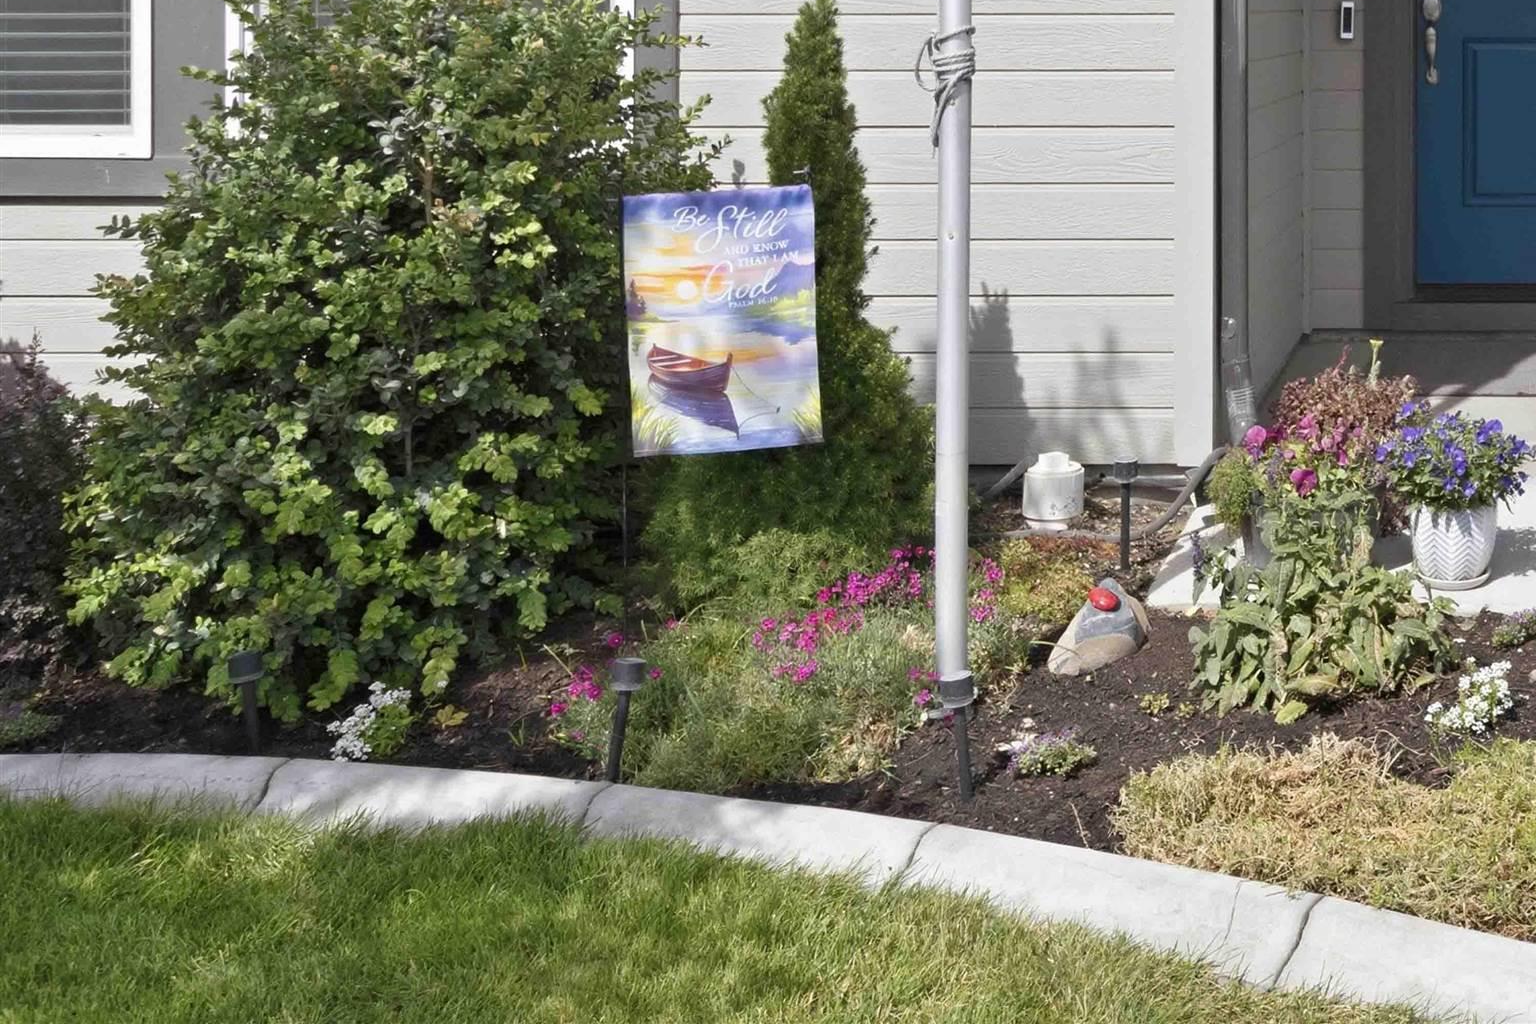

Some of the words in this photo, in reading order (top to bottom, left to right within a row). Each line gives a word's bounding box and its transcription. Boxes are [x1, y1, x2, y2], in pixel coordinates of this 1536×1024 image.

[673, 206, 710, 232] Be
[696, 205, 788, 253] Still
[753, 240, 789, 252] KNOW
[781, 251, 799, 262] AM
[704, 260, 777, 303] God
